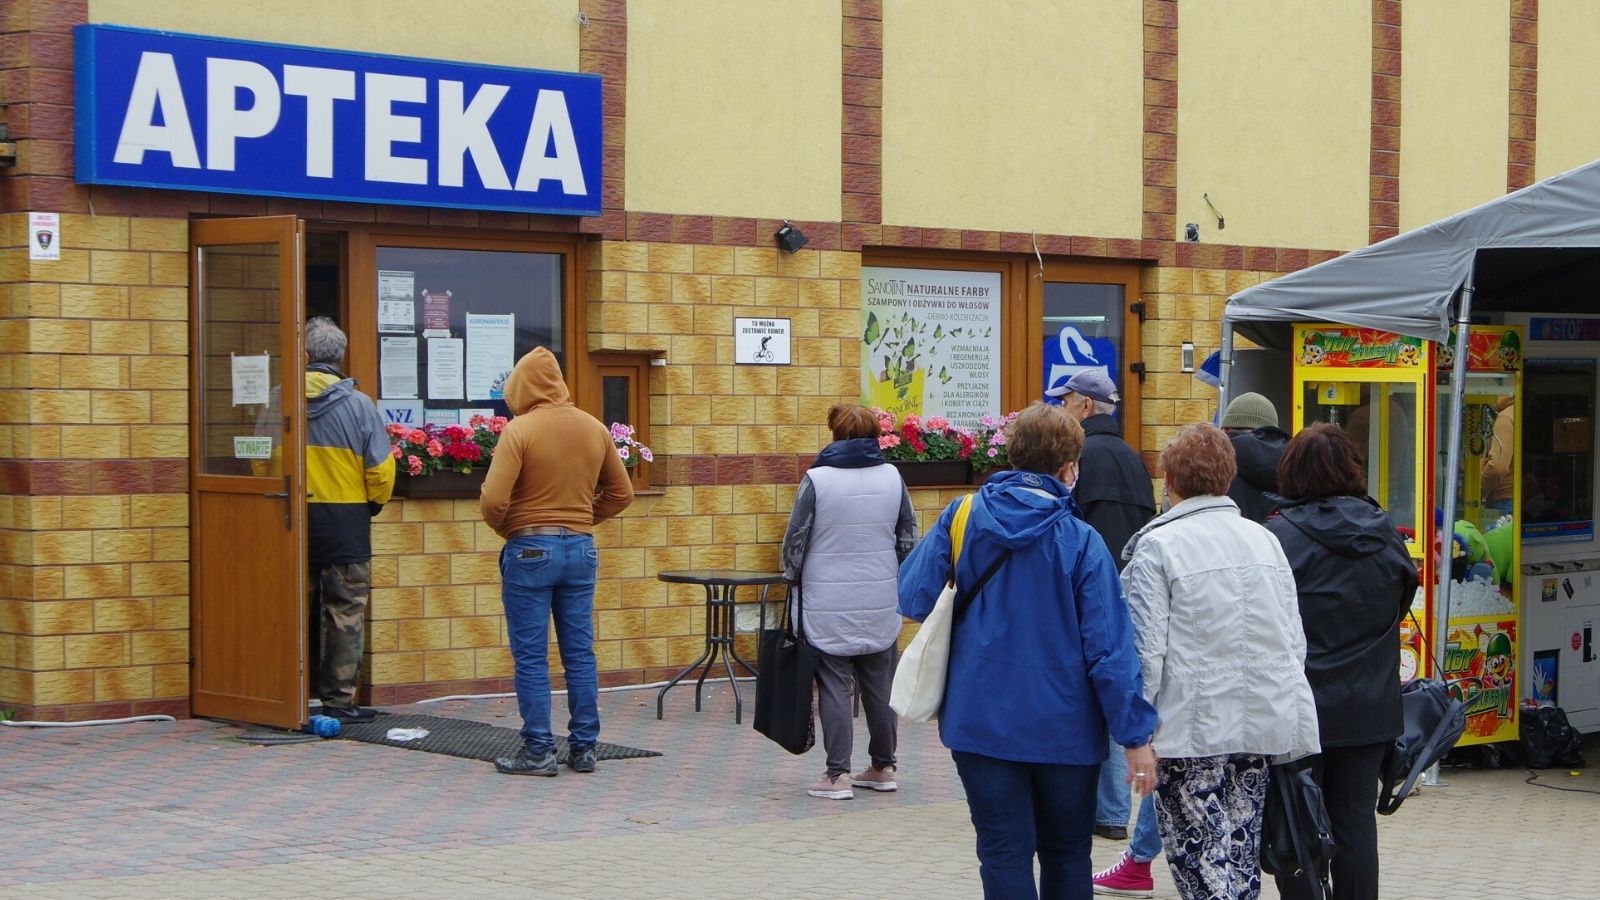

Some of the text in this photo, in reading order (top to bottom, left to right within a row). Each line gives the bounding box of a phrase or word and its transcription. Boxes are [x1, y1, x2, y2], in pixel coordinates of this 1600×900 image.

[112, 51, 588, 196] APTEKA
[907, 284, 959, 296] NATURALNE
[961, 286, 990, 297] FARBY
[867, 298, 907, 307] SZAMPONY
[912, 299, 945, 309] ODŻYWKI
[946, 301, 956, 309] DO
[958, 301, 990, 310] WŁOSÓW
[950, 344, 990, 354] WZMACNIAJĄ
[953, 353, 990, 362] REGENERUJĄ
[950, 362, 990, 370] USZKODZONE
[969, 371, 990, 379] WŁOSY
[957, 382, 990, 390] PRZYJAZNE
[943, 391, 990, 399] DLA ALERGIKÓW
[385, 408, 414, 424] NFZ
[236, 440, 271, 455] OTWARTE
